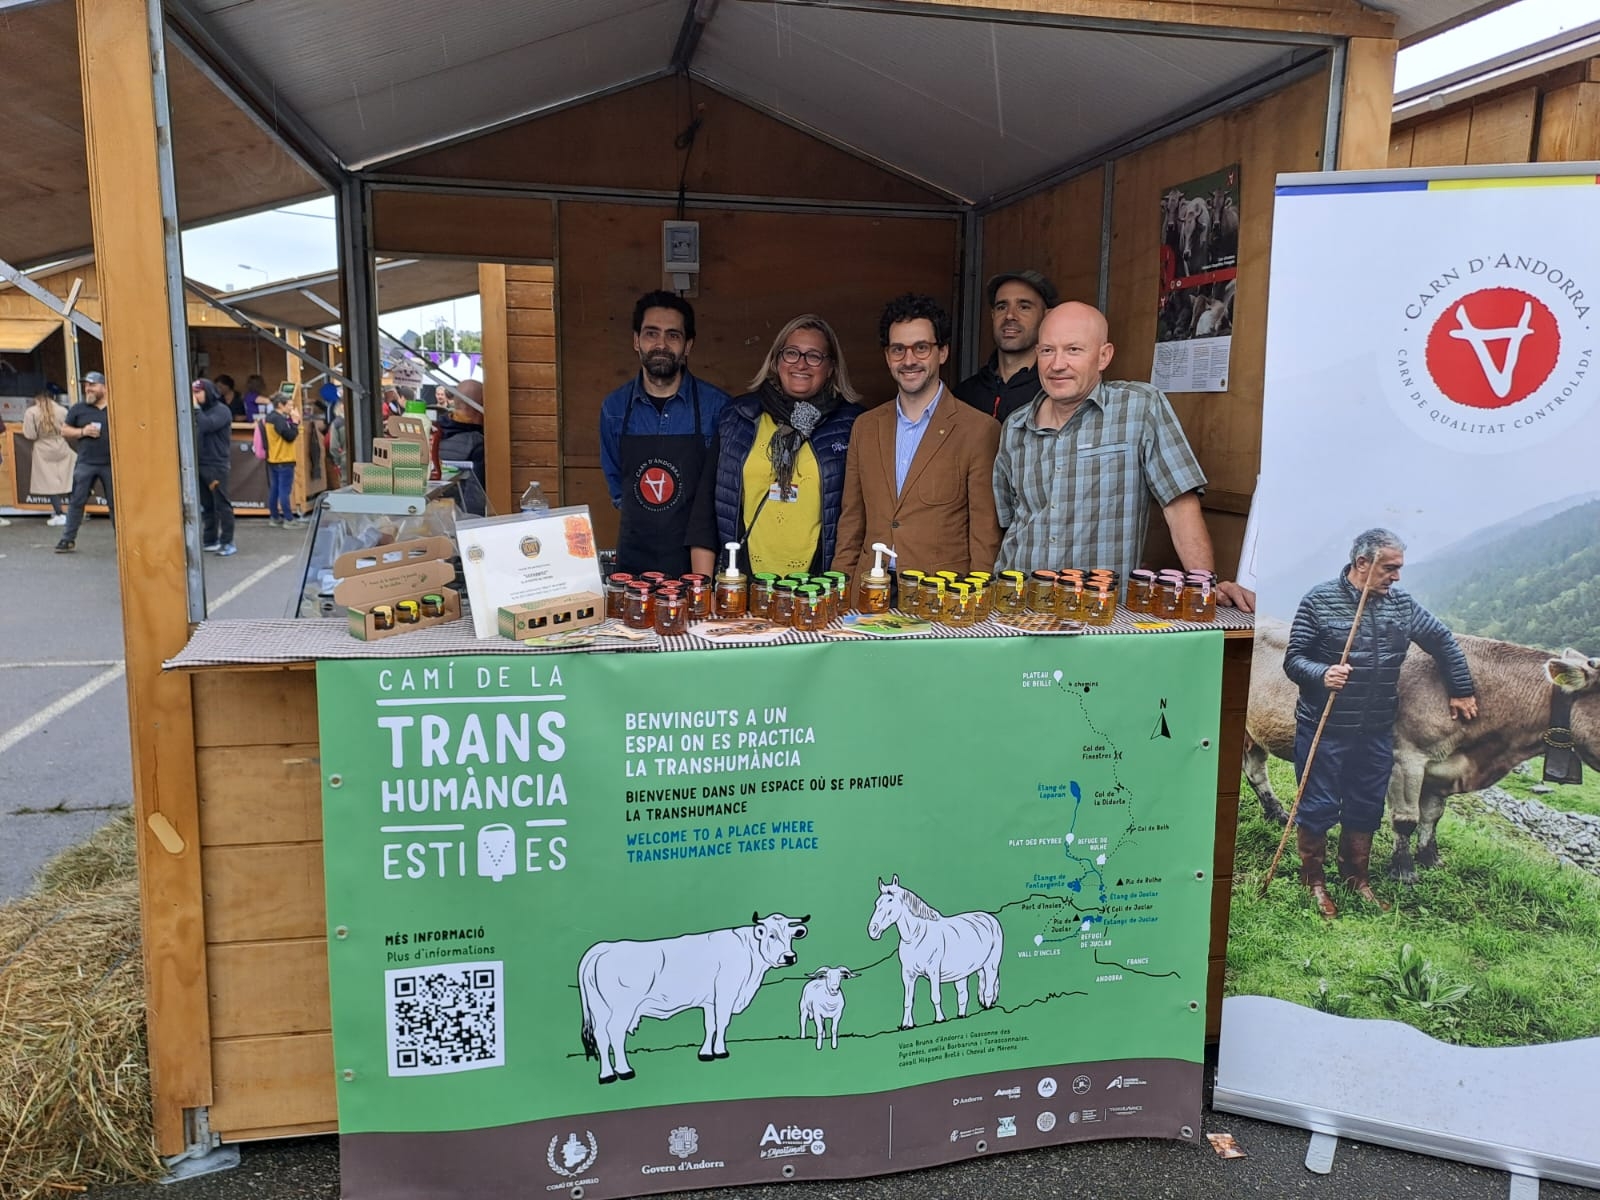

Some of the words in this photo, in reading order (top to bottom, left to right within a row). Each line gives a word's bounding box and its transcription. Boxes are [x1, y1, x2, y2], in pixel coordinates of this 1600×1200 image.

[1404, 267, 1460, 320] CARN
[1468, 253, 1591, 320] D'ANDORRA
[1397, 348, 1414, 388] CARN
[1410, 391, 1428, 409] DE
[1429, 409, 1506, 434] QUALITAT
[1513, 348, 1593, 429] CONTROLADA
[379, 662, 455, 691] CAMÍ
[477, 666, 511, 689] DE
[531, 665, 563, 687] LA
[1022, 671, 1049, 680] PLATEAU
[1022, 680, 1031, 688] DE
[1032, 679, 1052, 688] BEILLE
[1159, 698, 1168, 709] N
[625, 709, 738, 730] BENVINGUTS
[745, 708, 757, 726] A
[764, 706, 787, 725] UN
[377, 710, 566, 768] TRANS
[625, 734, 673, 754] ESPAI
[680, 733, 704, 752] ON
[712, 733, 731, 750] ES
[738, 727, 815, 748] PRACTICA
[1082, 744, 1093, 752] Col
[625, 759, 647, 778] LA
[654, 749, 801, 776] TRANSHUMÀNCIA
[382, 767, 567, 813] HUMÀNCIA
[626, 787, 697, 803] BIENVENUE
[702, 784, 735, 799] DANS
[740, 782, 757, 795] UN
[761, 779, 804, 793] ESPACE
[810, 776, 826, 790] OÙ
[830, 778, 844, 790] SE
[849, 774, 904, 790] PRATIQUE
[625, 809, 641, 822] LA
[646, 801, 748, 820] TRANSHUMANCE
[626, 830, 687, 846] WELCOME
[693, 828, 710, 842] TO
[714, 827, 724, 840] A
[728, 822, 767, 838] PLACE
[771, 820, 814, 835] WHERE
[1008, 839, 1024, 848] PLAT
[1025, 838, 1038, 846] DES
[627, 842, 732, 863] TRANSHUMANCE
[737, 838, 775, 853] TAKES
[781, 837, 819, 851] PLACE
[385, 932, 409, 946] MÉS
[413, 928, 485, 944] INFORMACIÓ
[387, 951, 409, 963] Plus
[414, 945, 496, 961] d'informations
[1017, 951, 1031, 959] VALL
[1126, 957, 1150, 966] FRANCE
[759, 1123, 824, 1146] Ariège
[641, 1163, 676, 1175] Govern
[678, 1159, 725, 1172] d'Andorra
